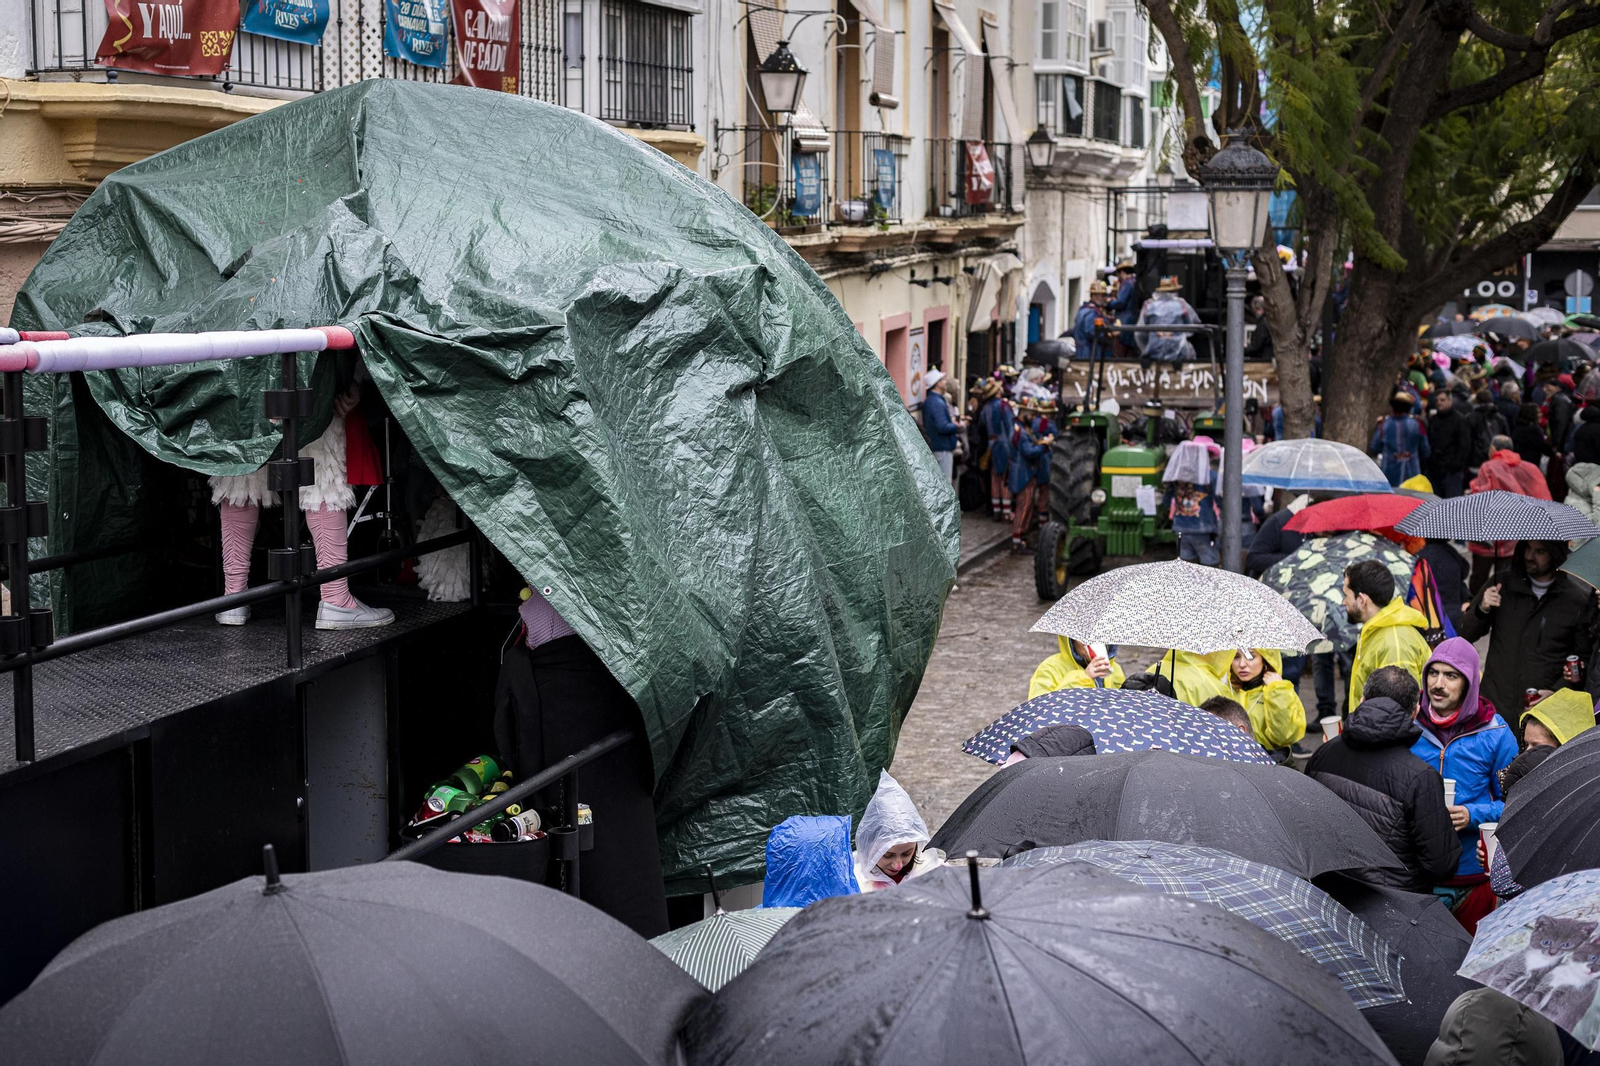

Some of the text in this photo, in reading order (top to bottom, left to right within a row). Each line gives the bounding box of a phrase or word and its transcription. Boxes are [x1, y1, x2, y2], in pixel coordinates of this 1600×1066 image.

[138, 3, 155, 38] Y
[274, 9, 300, 29] RIVES
[412, 37, 433, 55] RIVES
[464, 40, 477, 69] DE
